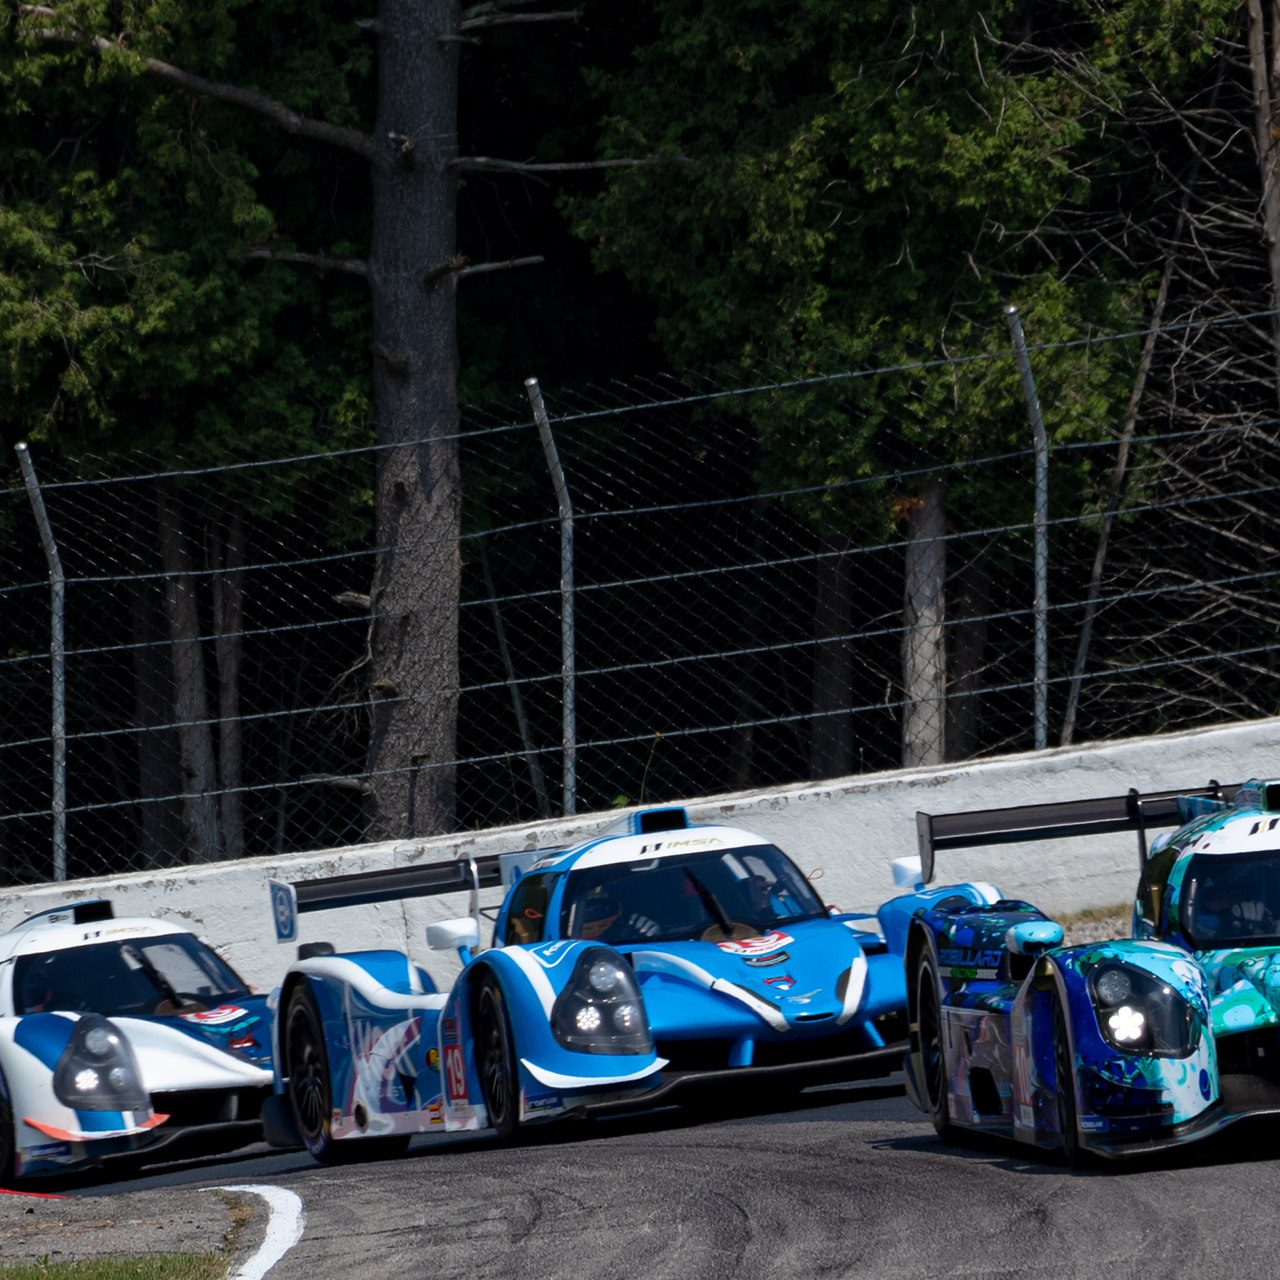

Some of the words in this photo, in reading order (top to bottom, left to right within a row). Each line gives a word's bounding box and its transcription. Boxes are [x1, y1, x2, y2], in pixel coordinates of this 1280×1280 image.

[666, 838, 724, 849] IMSA
[938, 949, 1002, 967] ROBILLARD
[445, 1049, 466, 1096] 19
